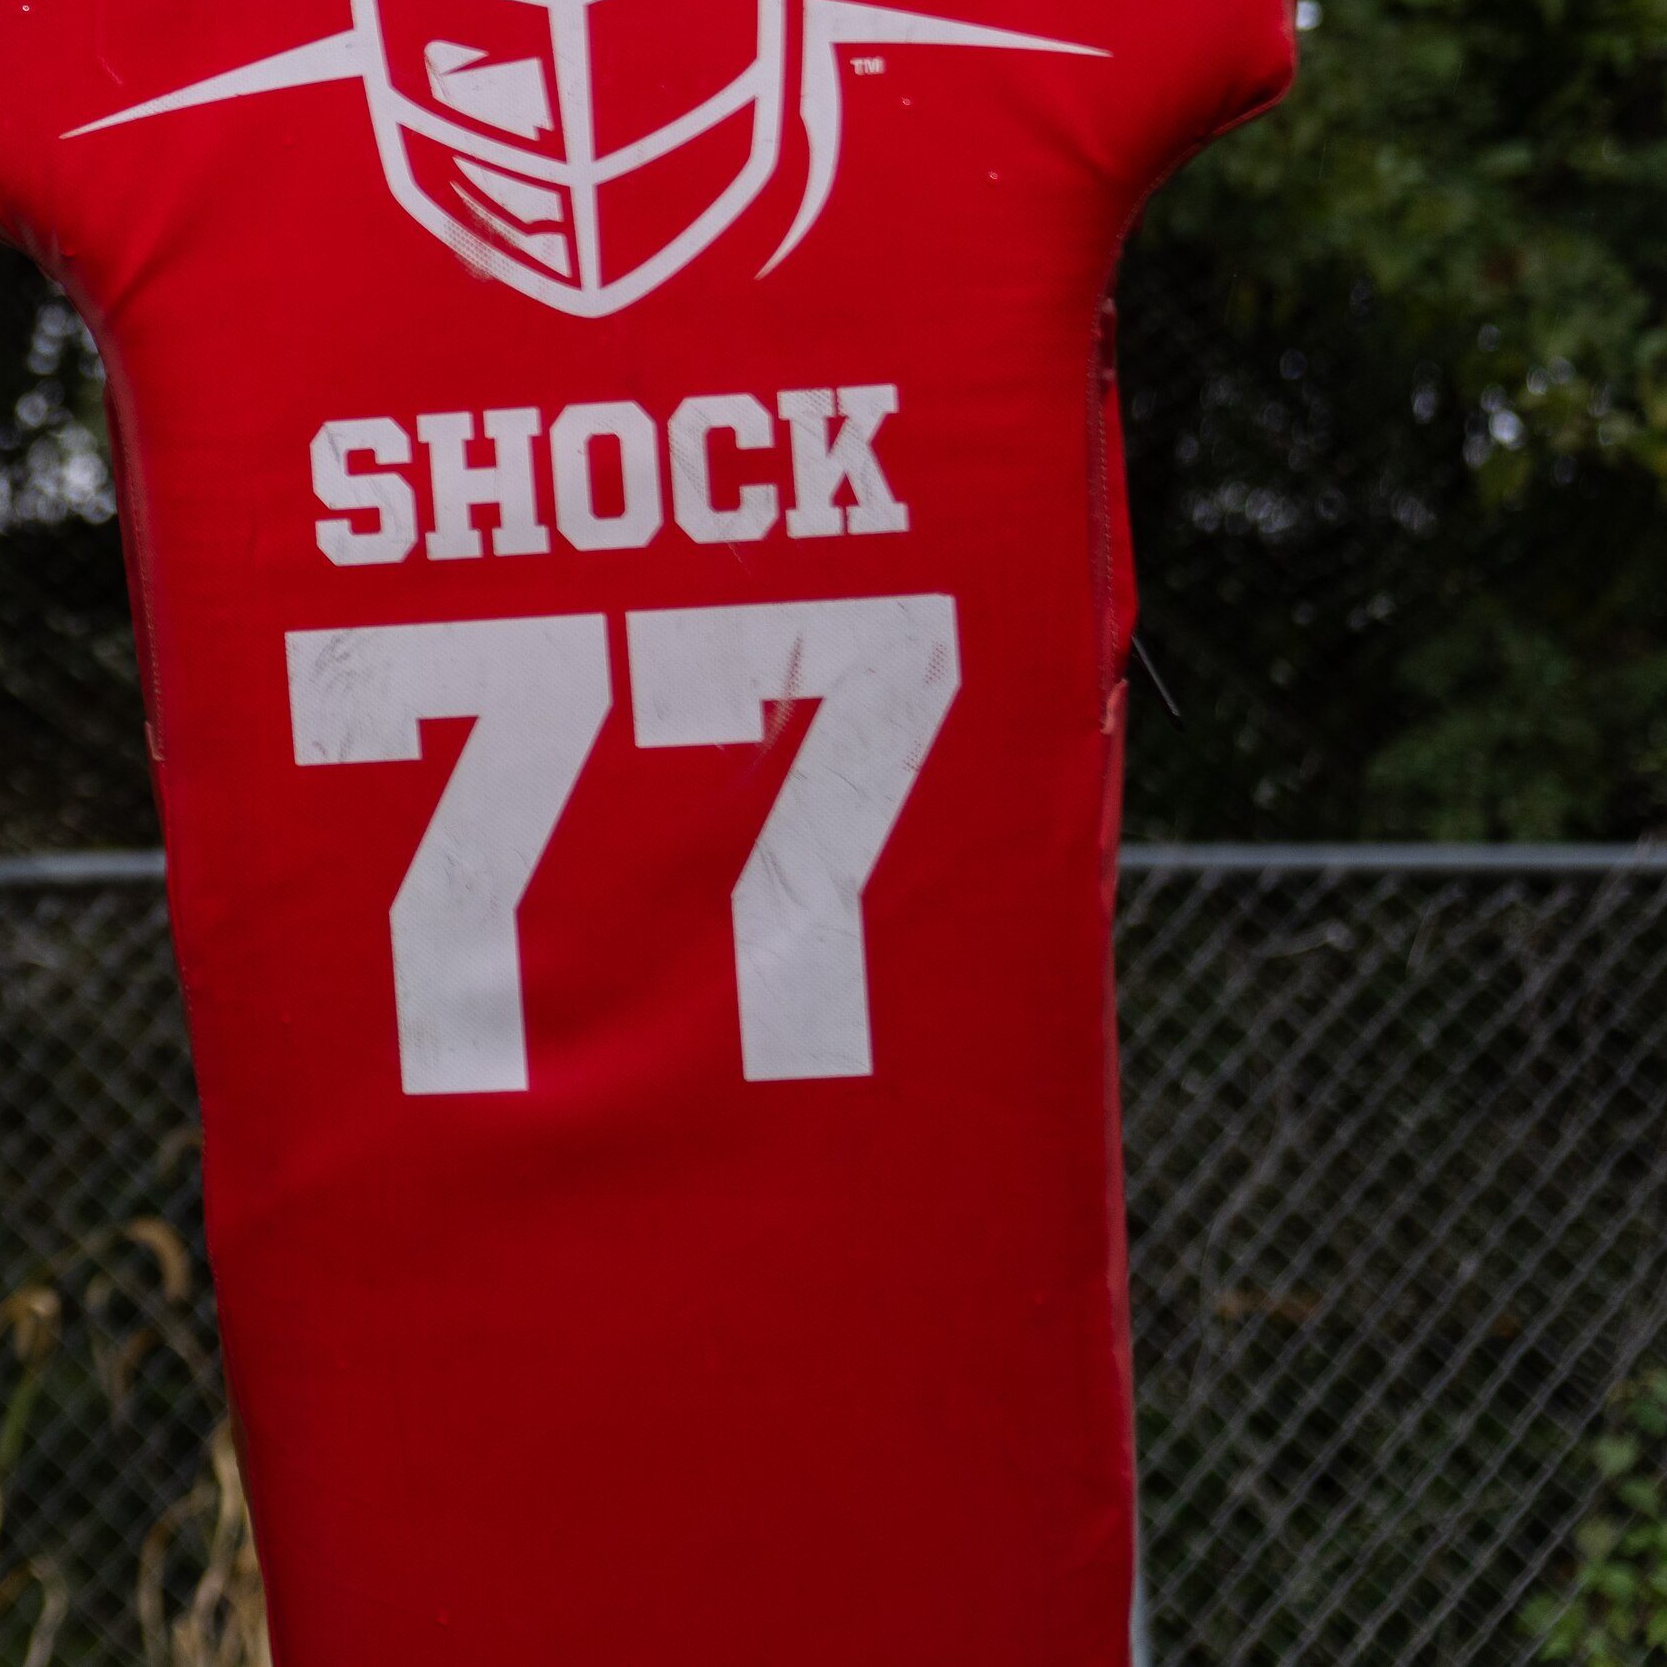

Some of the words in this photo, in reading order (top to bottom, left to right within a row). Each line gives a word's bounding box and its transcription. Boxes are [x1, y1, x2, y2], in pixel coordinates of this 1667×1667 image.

[850, 56, 886, 76] TM
[308, 384, 910, 567] SHOCK
[284, 593, 961, 1095] 77
